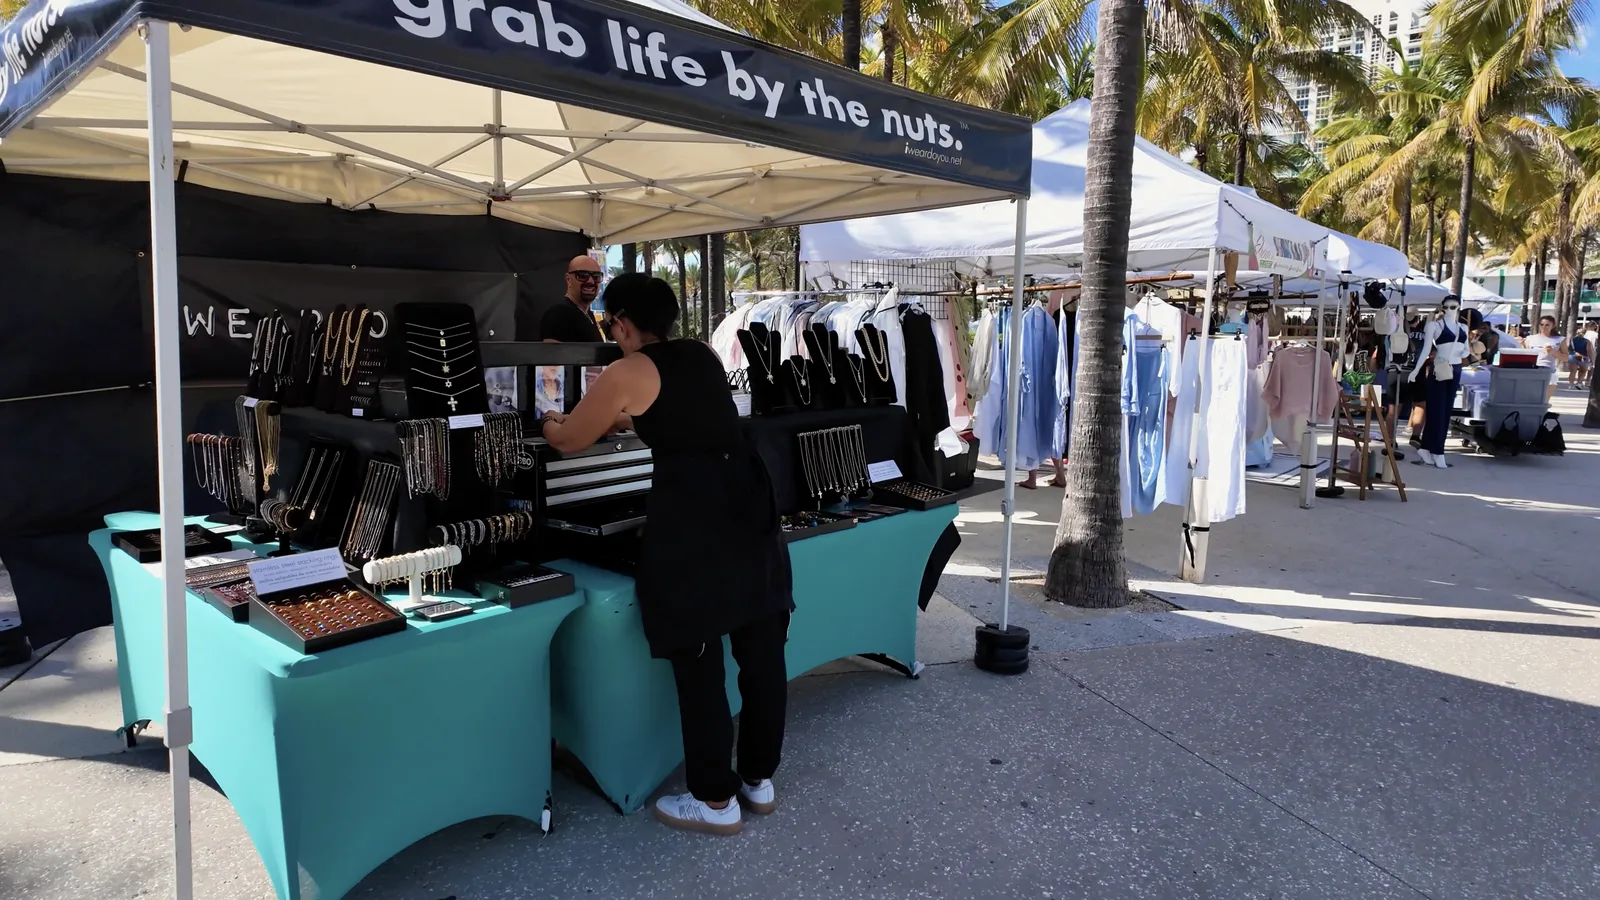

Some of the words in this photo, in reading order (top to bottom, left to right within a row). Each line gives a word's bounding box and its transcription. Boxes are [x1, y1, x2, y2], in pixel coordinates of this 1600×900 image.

[393, 0, 587, 58] grab
[607, 18, 708, 87] life
[720, 50, 785, 119] by
[800, 77, 870, 128] the
[880, 108, 964, 151] nuts.
[904, 141, 963, 166] iweardoyou.net
